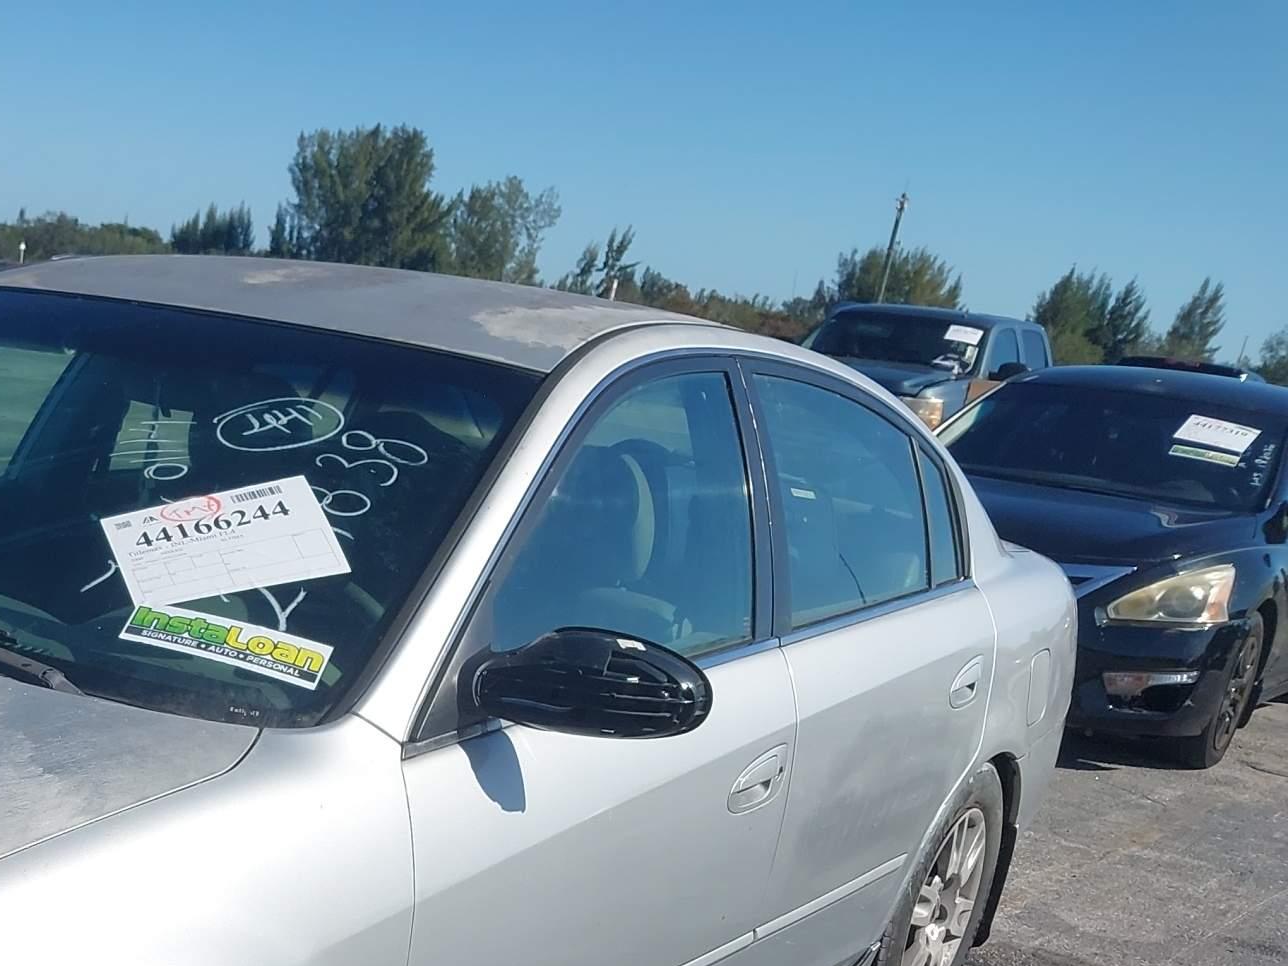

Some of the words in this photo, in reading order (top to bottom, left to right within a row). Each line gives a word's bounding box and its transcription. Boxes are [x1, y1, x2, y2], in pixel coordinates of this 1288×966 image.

[135, 500, 290, 547] 44166244
[130, 605, 325, 674] InstaLoan
[141, 629, 199, 648] SIGNATURE
[206, 644, 238, 659] AUTO
[246, 655, 301, 678] PERSONAL
